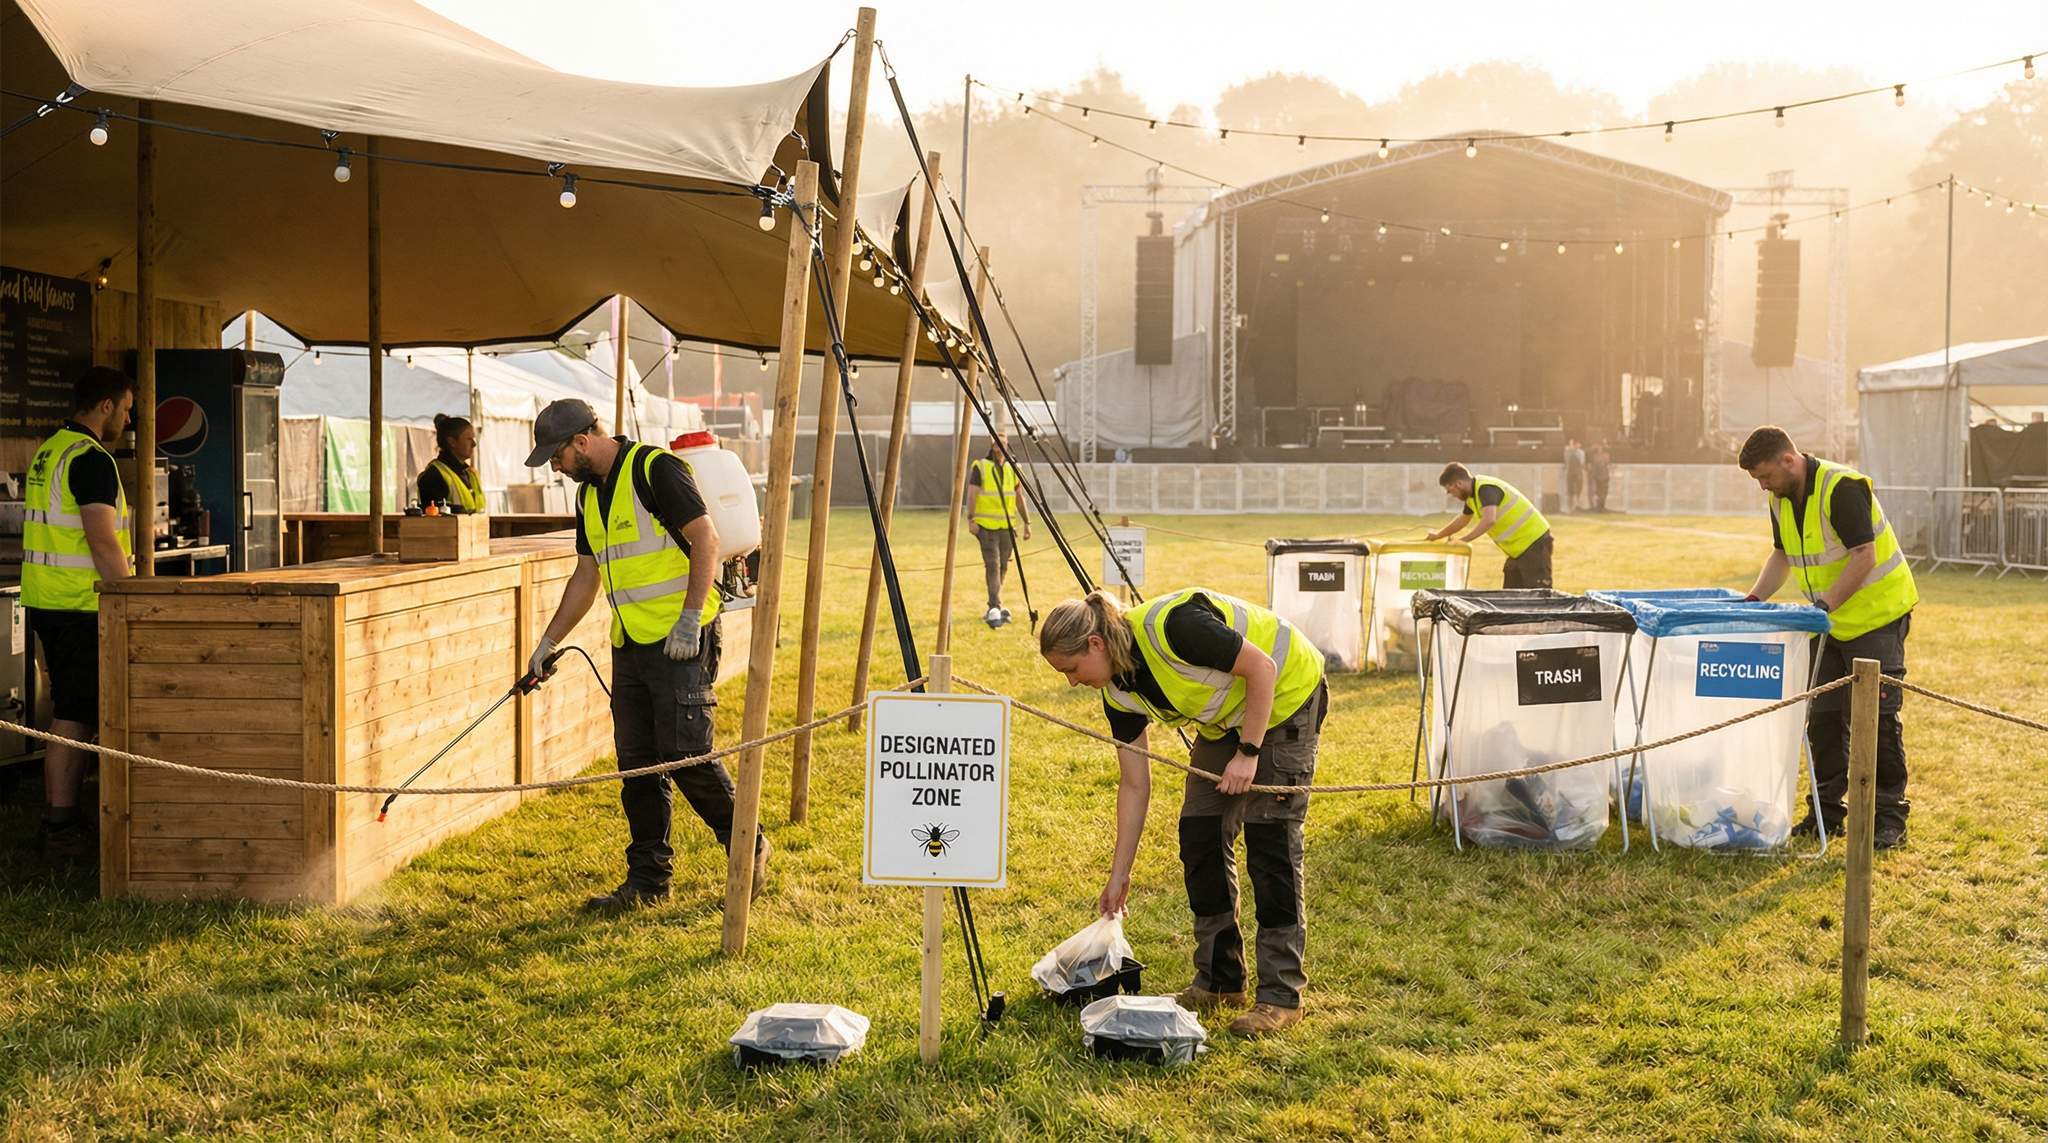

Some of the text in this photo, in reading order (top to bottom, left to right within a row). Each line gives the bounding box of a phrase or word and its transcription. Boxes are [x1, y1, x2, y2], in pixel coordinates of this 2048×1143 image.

[1534, 668, 1582, 685] TRASH
[1700, 662, 1781, 680] RECYCLING
[880, 735, 996, 756] DESIGNATED
[880, 761, 995, 782] POLLINATOR
[912, 787, 962, 807] ZONE
